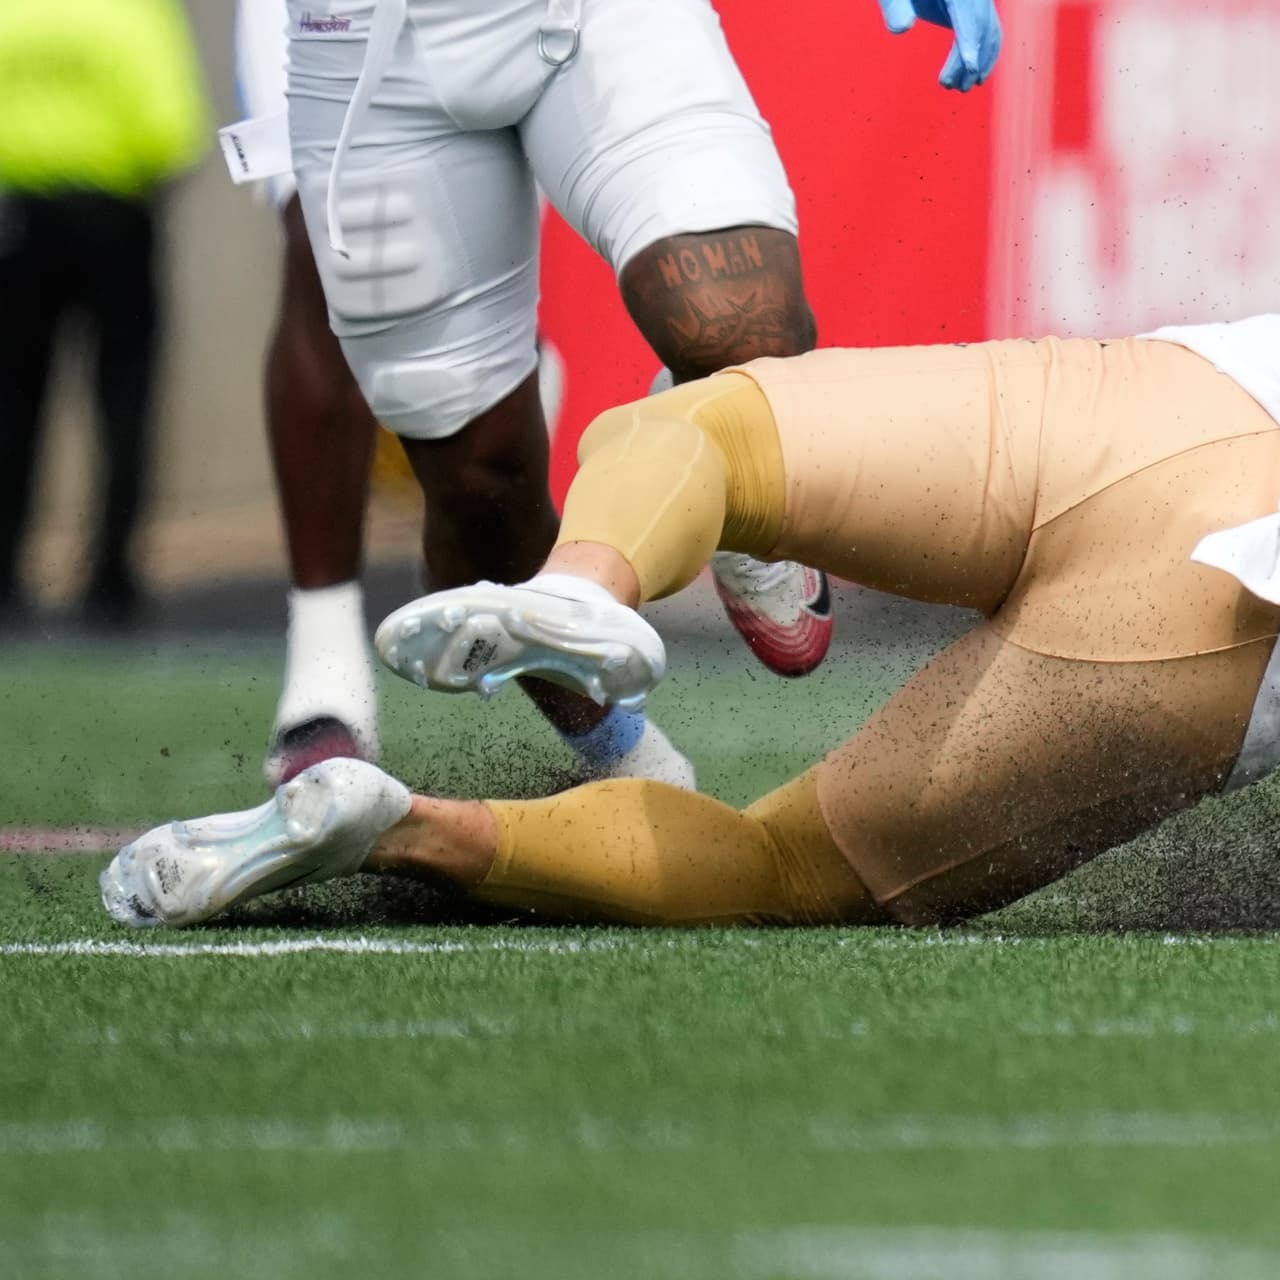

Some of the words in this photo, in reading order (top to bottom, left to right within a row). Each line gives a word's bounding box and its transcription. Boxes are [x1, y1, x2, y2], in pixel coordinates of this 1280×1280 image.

[299, 10, 352, 34] Houston
[657, 247, 701, 289] NO
[701, 234, 764, 279] MAN
